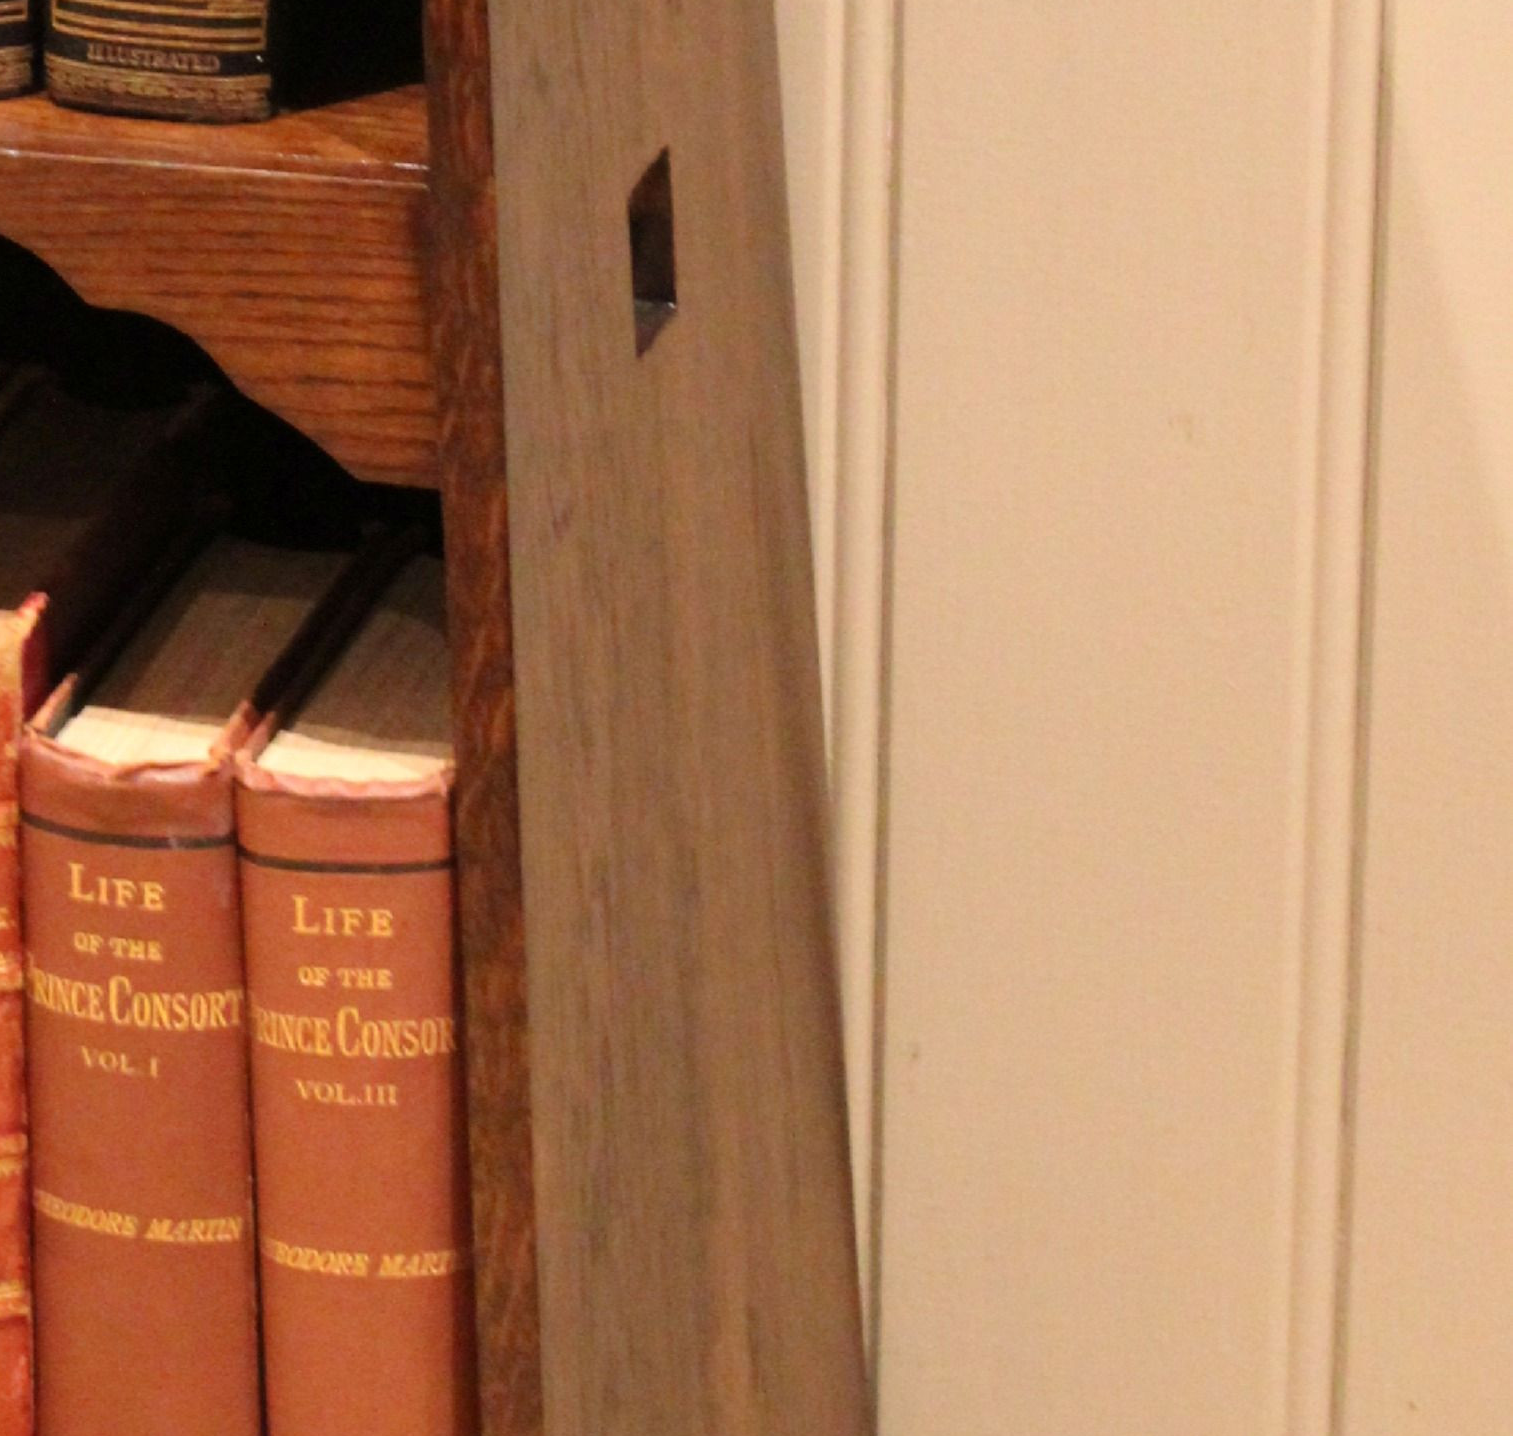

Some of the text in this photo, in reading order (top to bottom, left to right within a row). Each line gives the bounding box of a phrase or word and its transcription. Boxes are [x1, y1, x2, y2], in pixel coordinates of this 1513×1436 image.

[87, 41, 223, 74] ILLUSTRATED
[67, 862, 166, 912] LIFE
[290, 893, 394, 938] LIFE
[73, 930, 164, 962] OF THE
[297, 965, 393, 990] OF THE
[107, 974, 244, 1032] CONSORT
[337, 1004, 456, 1059] CONSOR
[148, 1056, 159, 1079] I
